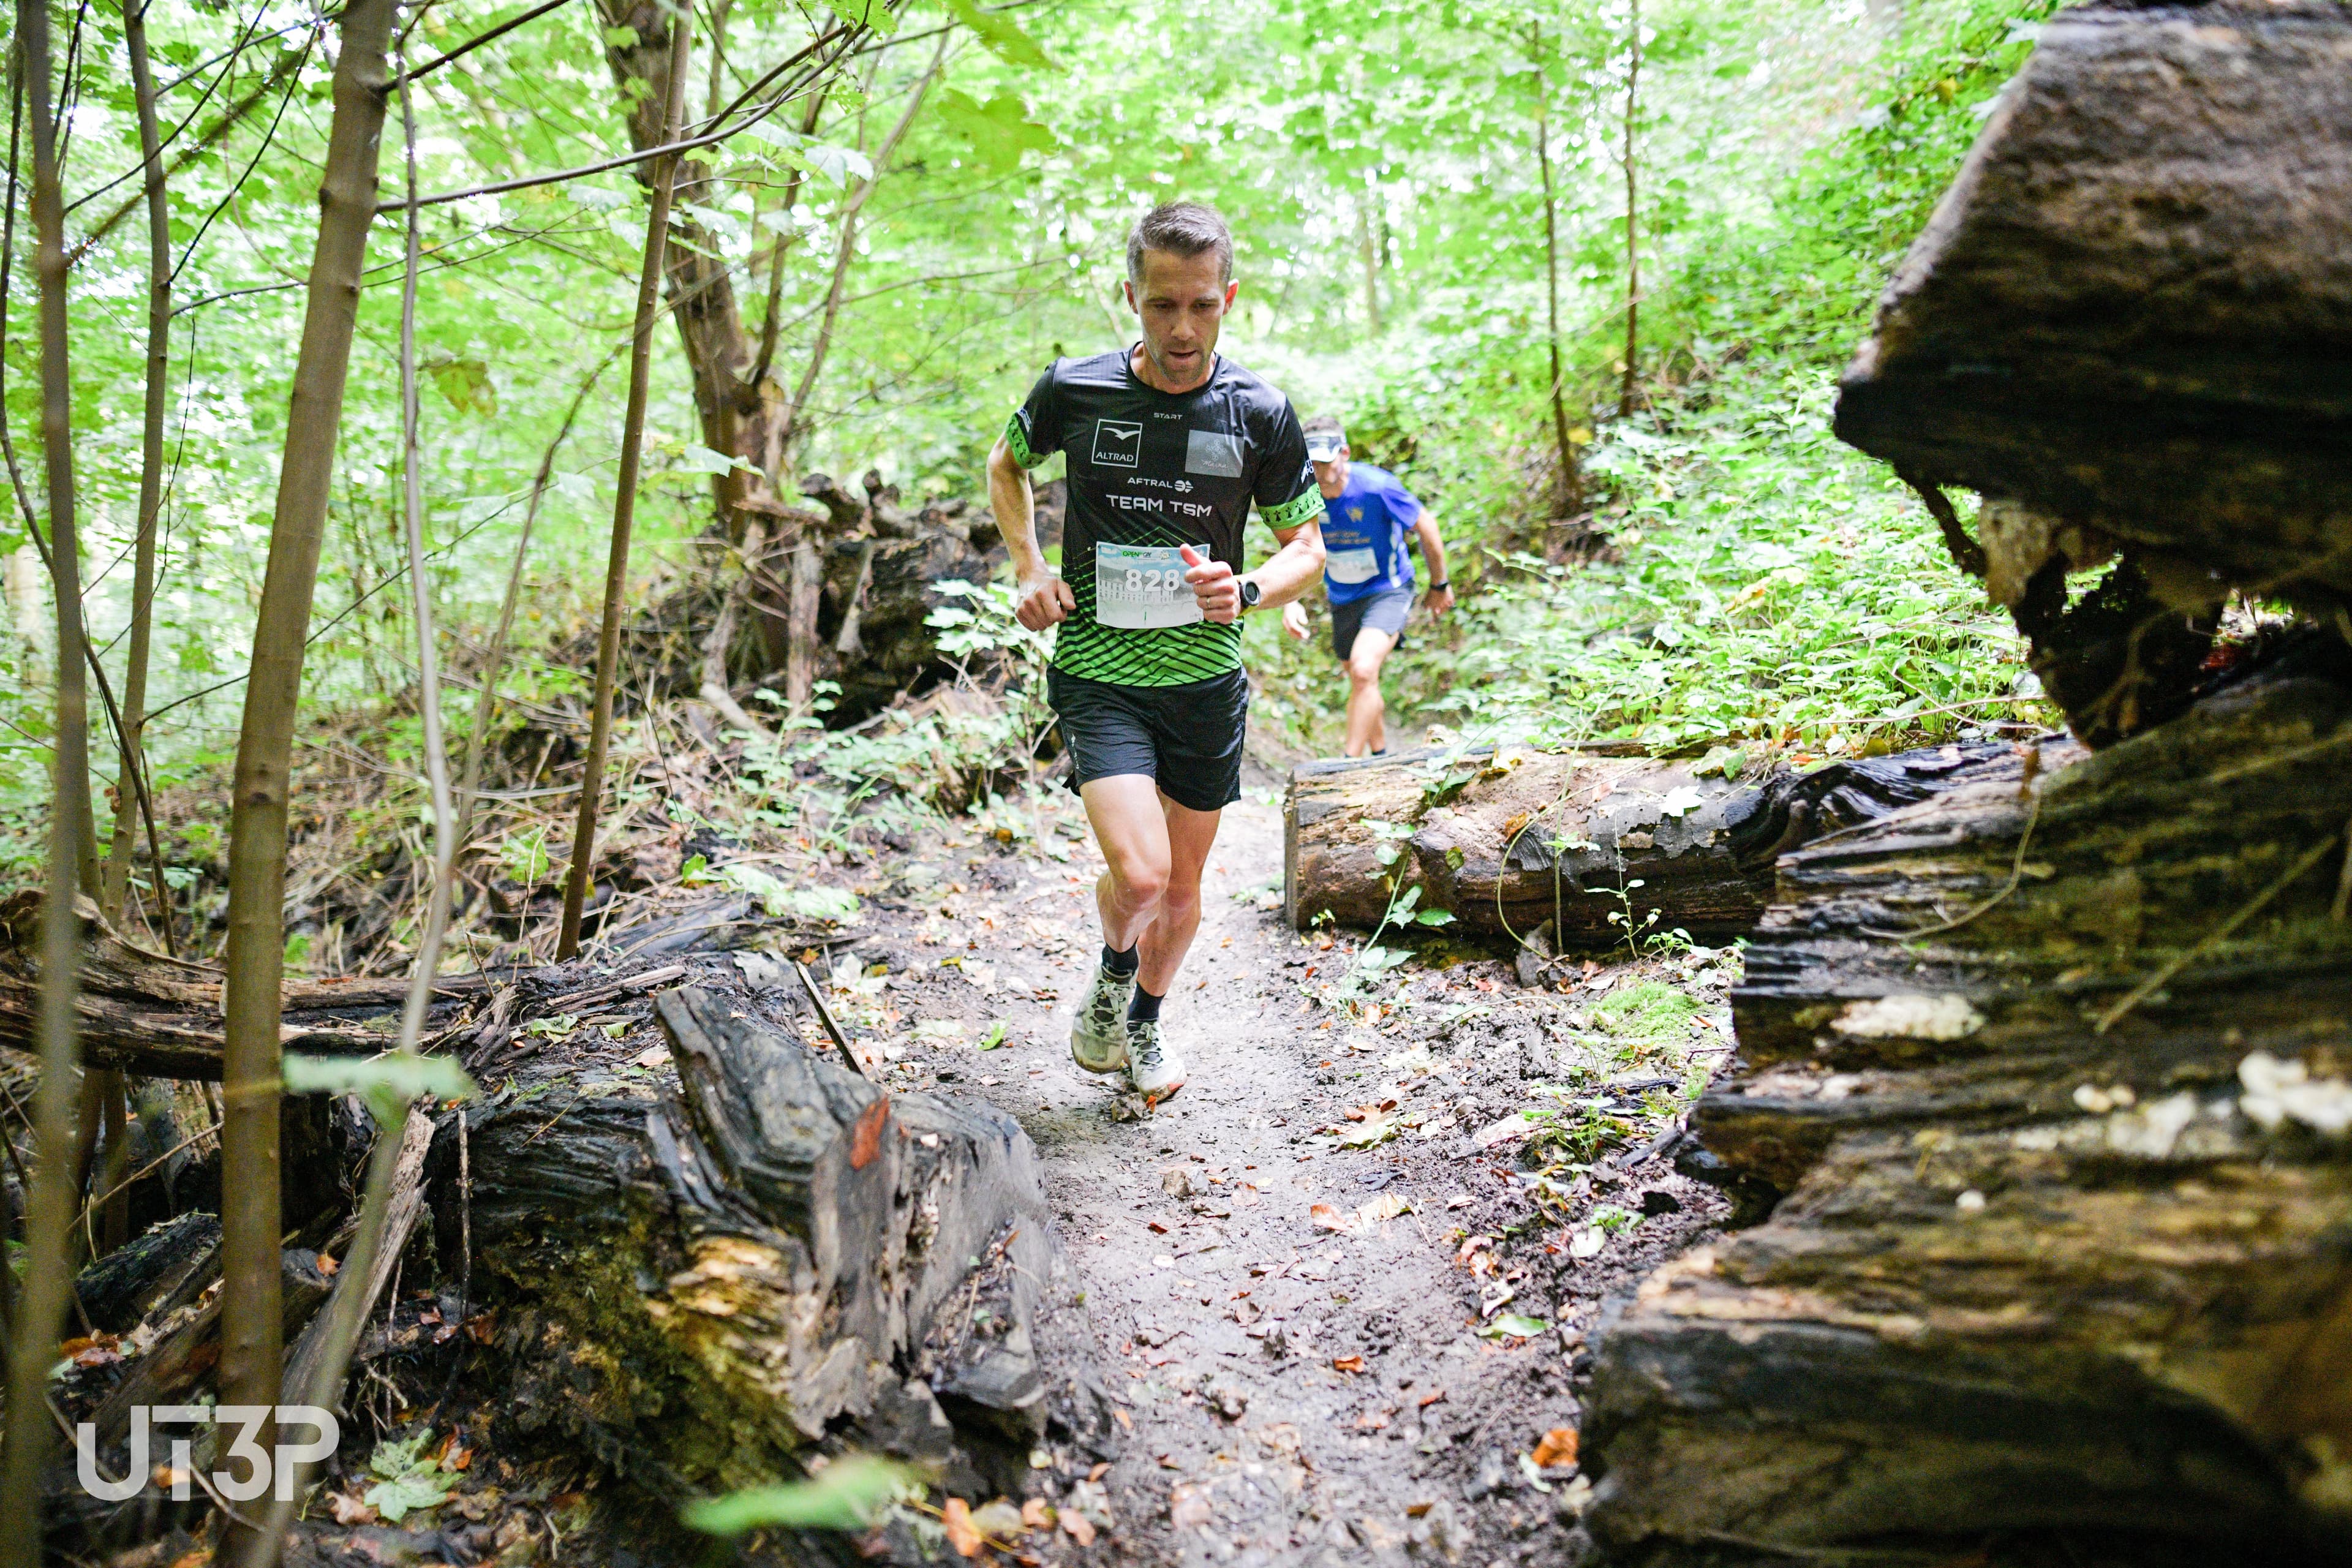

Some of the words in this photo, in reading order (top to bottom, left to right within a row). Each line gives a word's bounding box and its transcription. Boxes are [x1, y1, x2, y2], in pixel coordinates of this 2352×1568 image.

[1096, 451, 1134, 462] ALTRAD
[1127, 477, 1173, 488] AFTRAL
[1106, 494, 1163, 512] TEAM
[1169, 500, 1212, 518] TSM
[1126, 569, 1180, 592] 828
